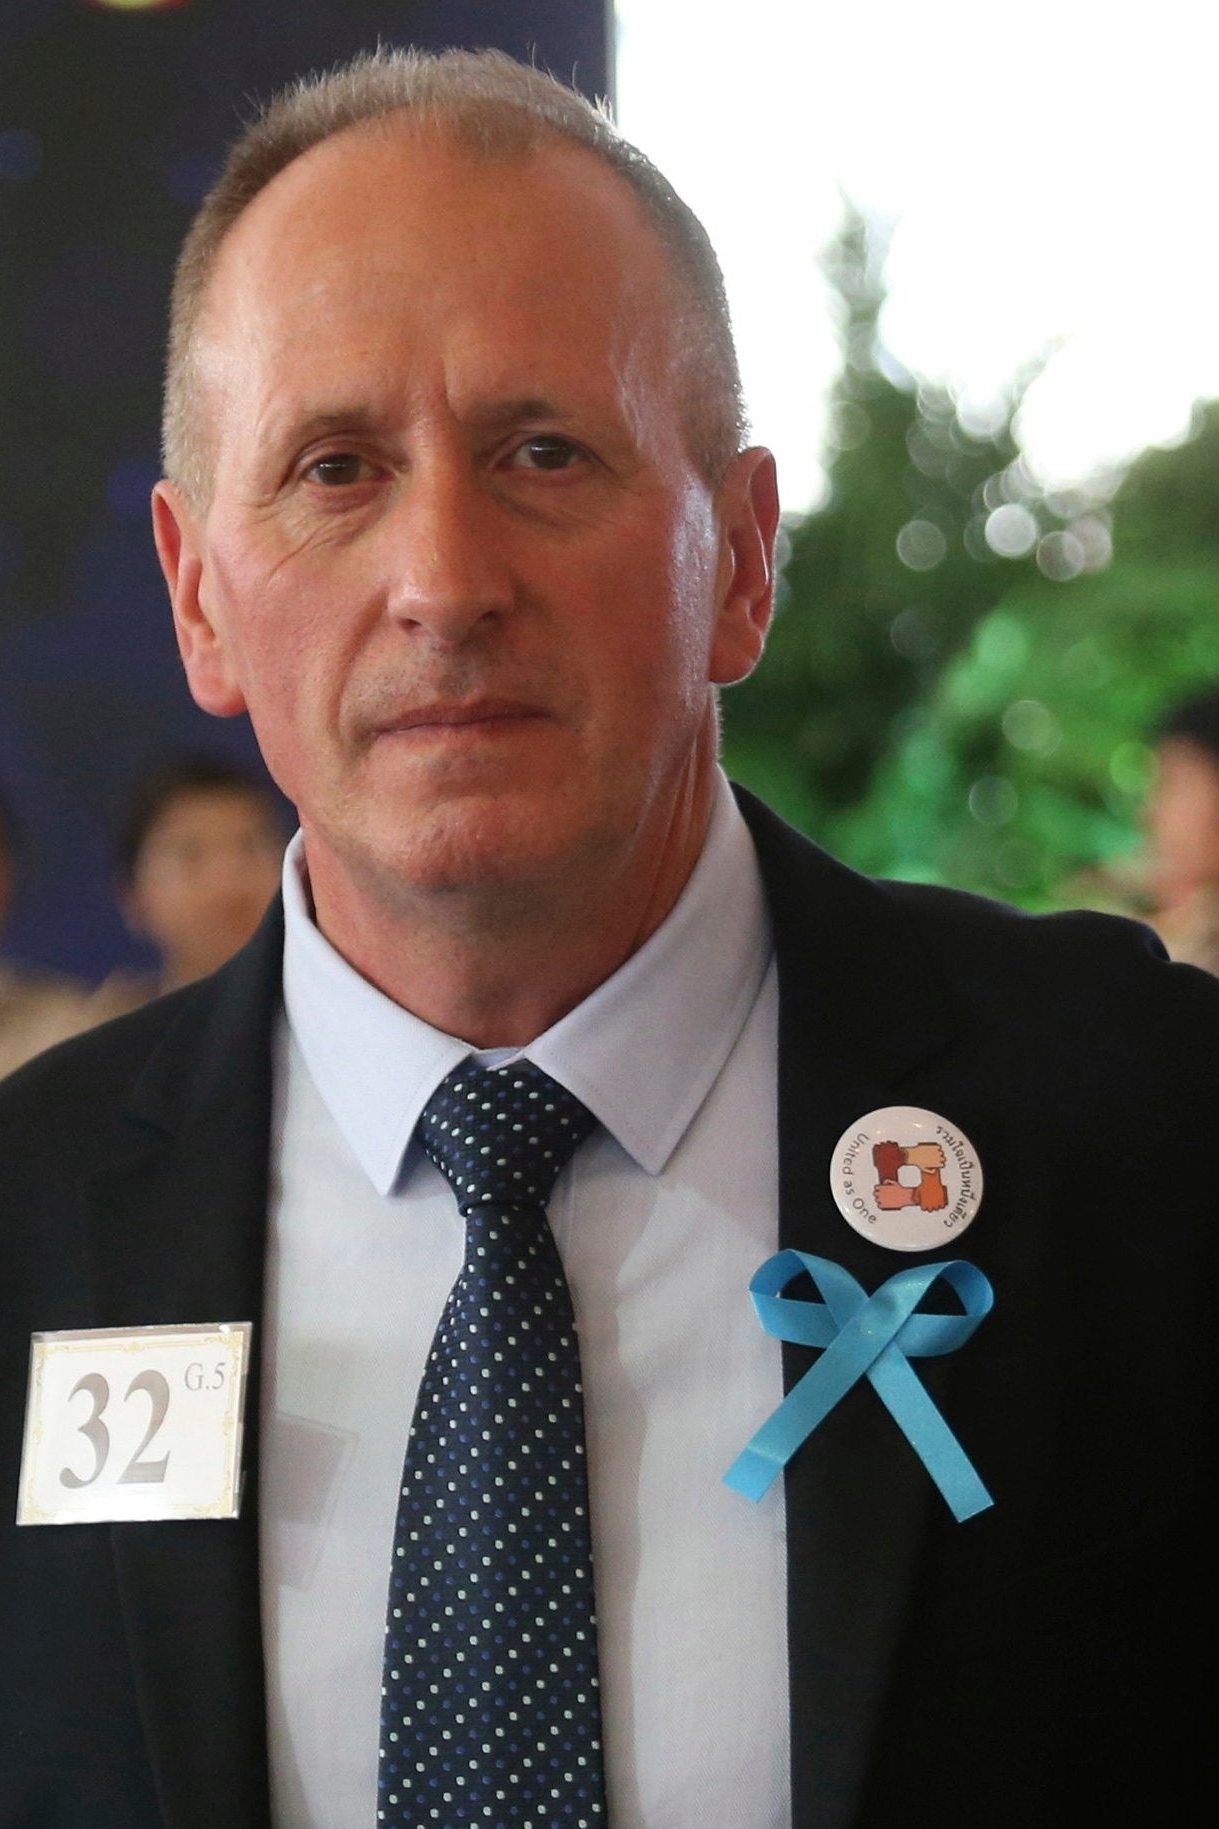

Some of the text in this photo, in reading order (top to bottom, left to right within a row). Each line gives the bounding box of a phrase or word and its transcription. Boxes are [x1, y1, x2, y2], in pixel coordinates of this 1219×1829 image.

[842, 1132, 877, 1224] United as One
[59, 1361, 226, 1489] 32 G.5
